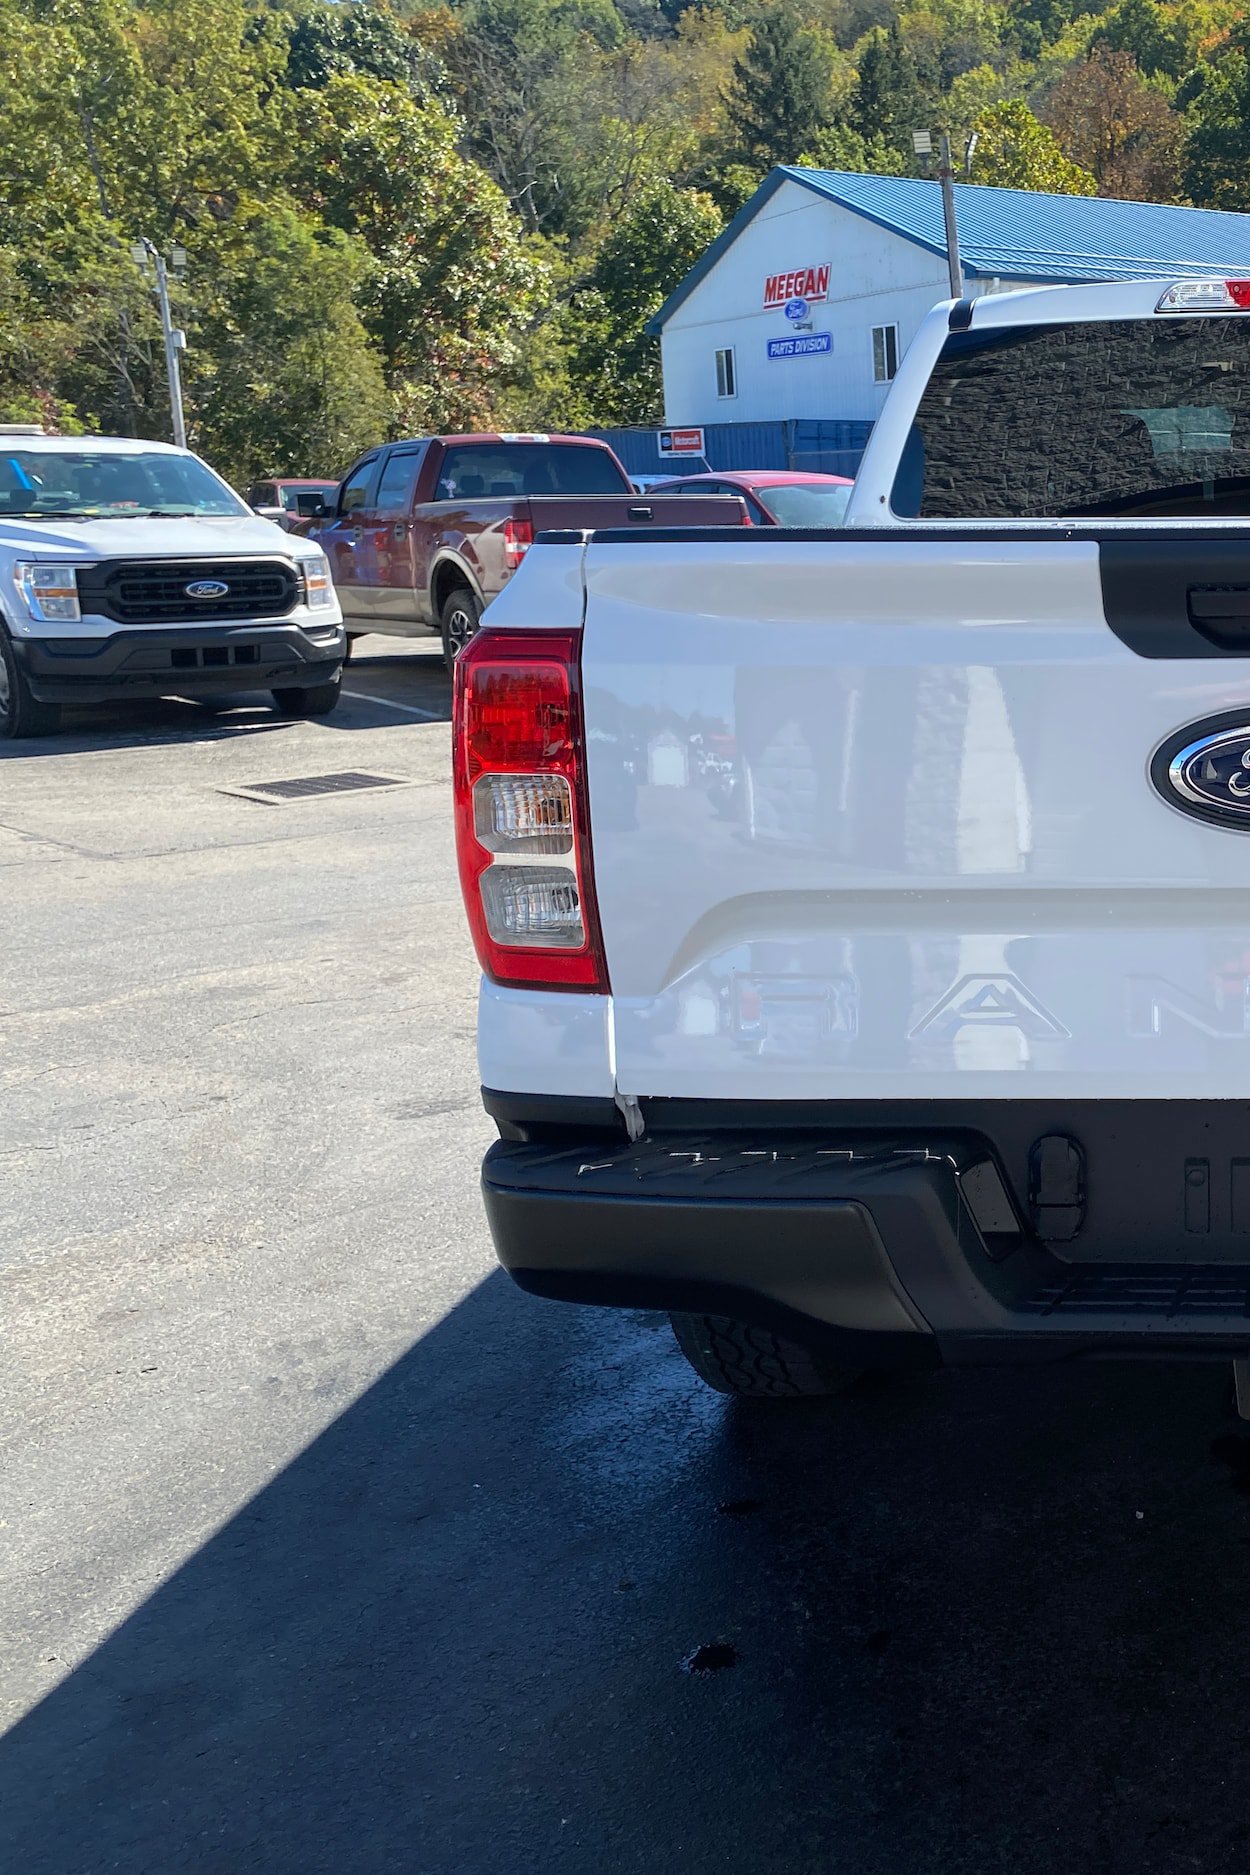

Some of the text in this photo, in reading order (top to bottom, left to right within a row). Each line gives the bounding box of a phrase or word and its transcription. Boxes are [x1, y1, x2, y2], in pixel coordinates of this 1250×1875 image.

[764, 265, 829, 303] MEEGAN
[770, 337, 829, 356] PARTS DIVISION
